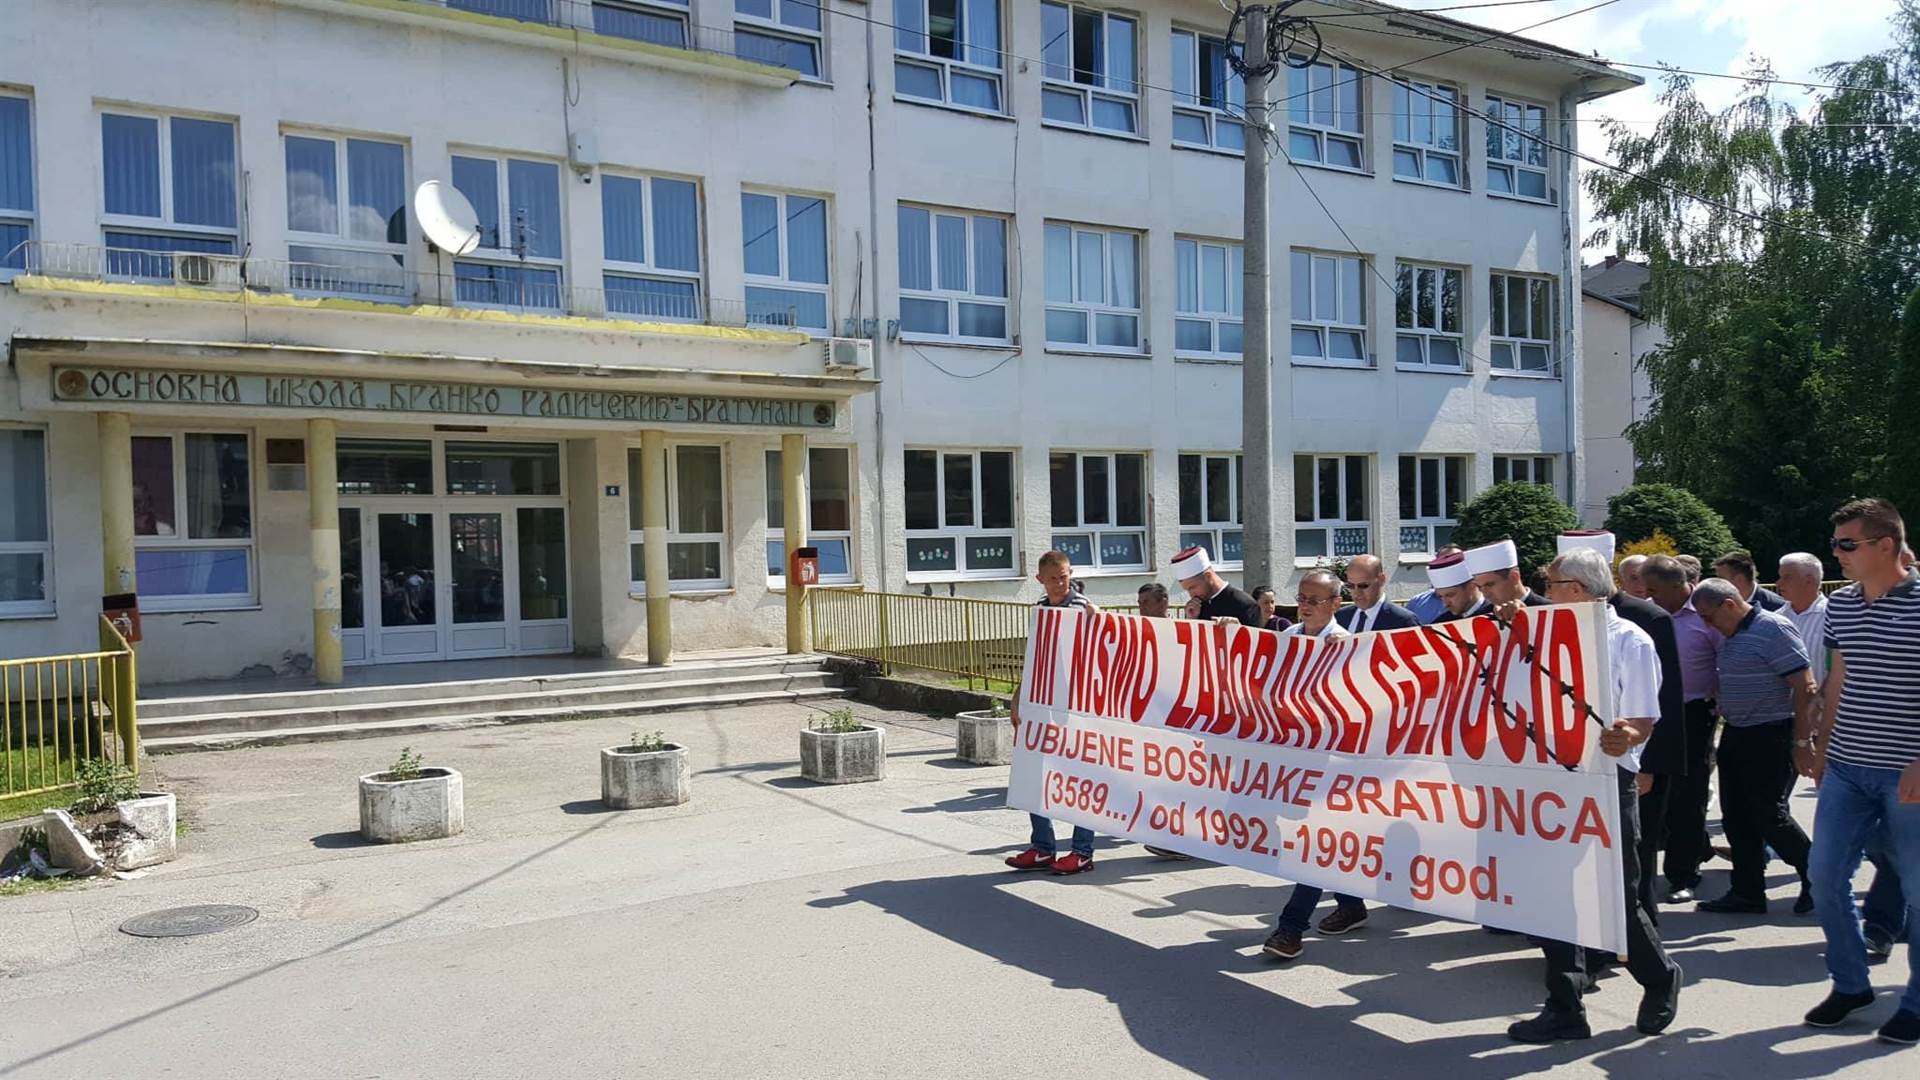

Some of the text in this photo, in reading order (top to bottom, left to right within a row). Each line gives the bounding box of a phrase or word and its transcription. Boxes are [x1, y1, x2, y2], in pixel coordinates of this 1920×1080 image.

[90, 371, 241, 402] ОСНОВНА
[265, 378, 366, 408] ШКОЛА
[1029, 608, 1586, 766] MI NISMO ZABORAVILI GENOCID
[1025, 720, 1134, 772] UBIJENE
[1143, 740, 1324, 808] BOŠNJAKE
[1326, 773, 1612, 849] BRATUNCA
[1043, 770, 1513, 905] (3589...) od 1992.-1995. god.
